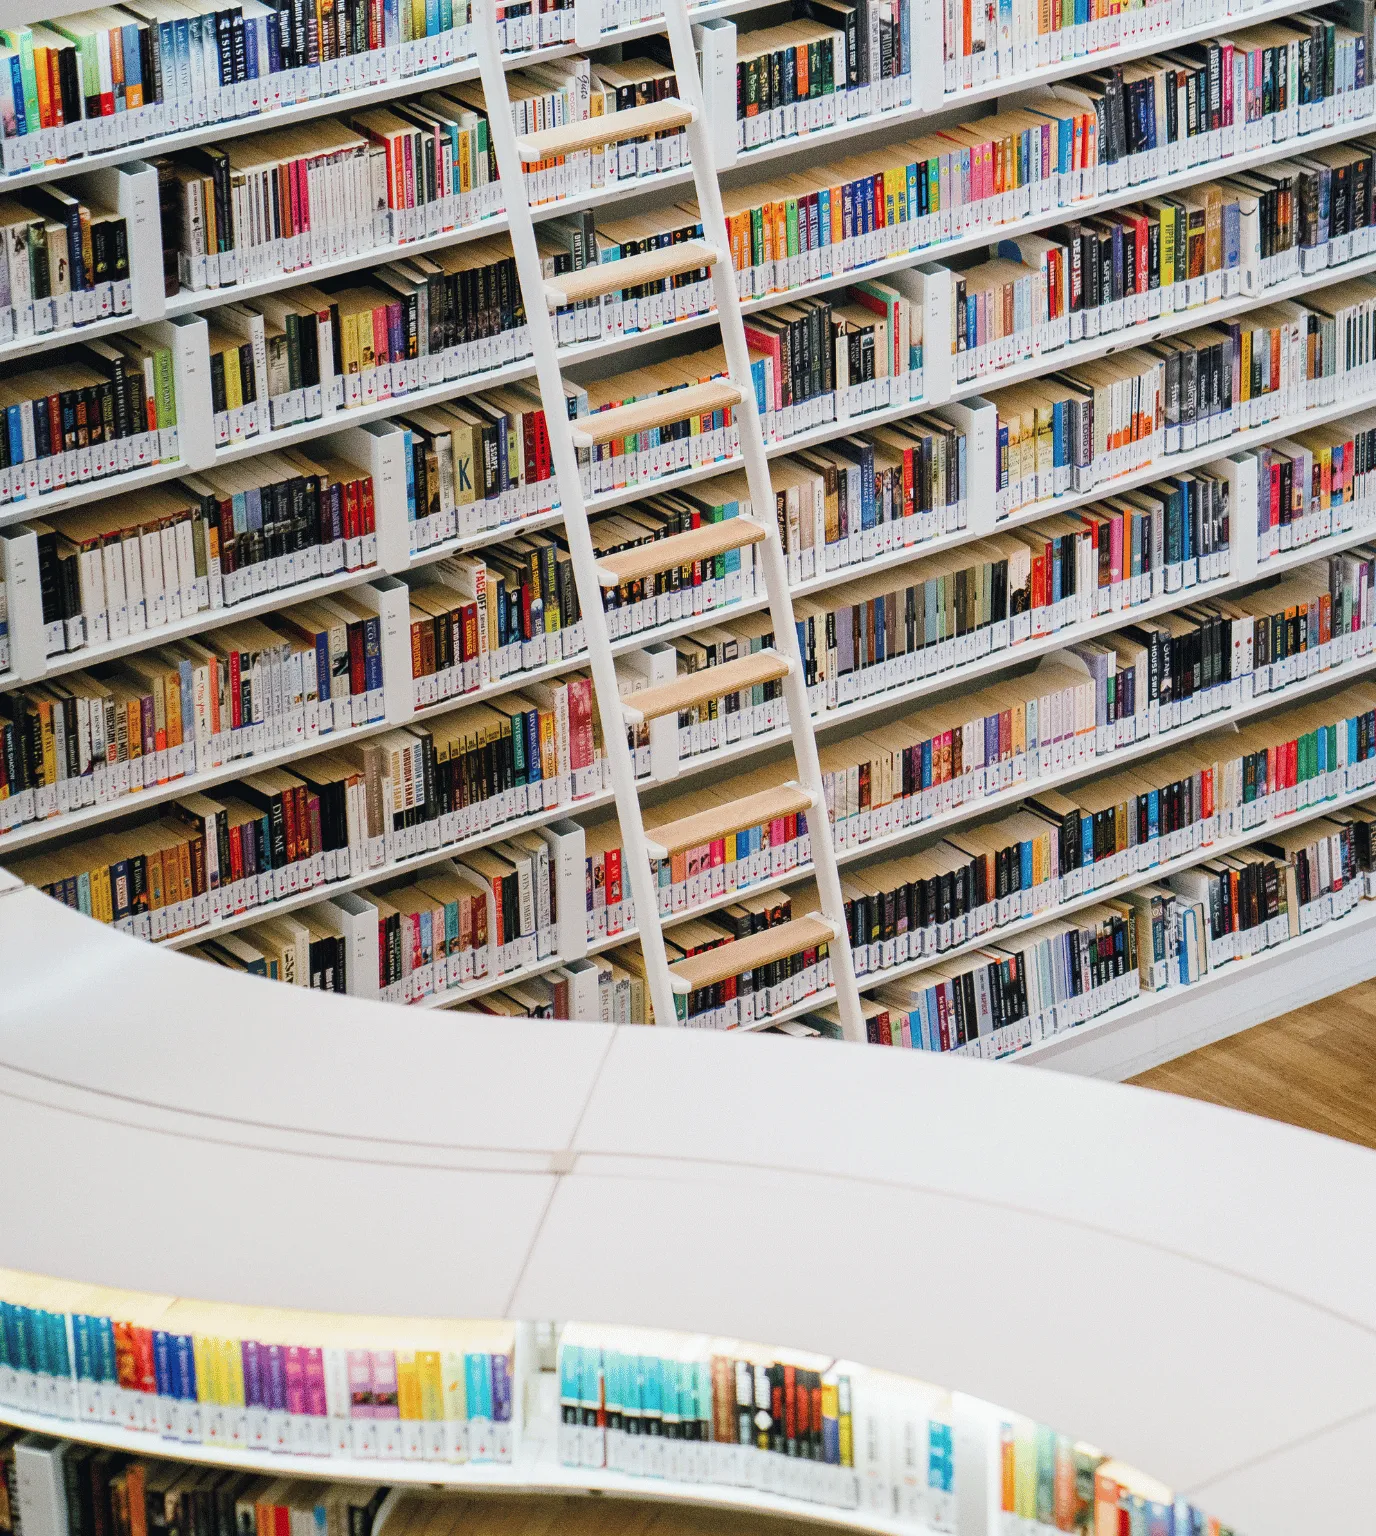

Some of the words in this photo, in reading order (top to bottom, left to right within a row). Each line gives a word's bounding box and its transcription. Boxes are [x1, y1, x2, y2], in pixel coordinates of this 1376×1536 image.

[280, 10, 289, 47] Singularity
[295, 28, 305, 52] Gravity
[337, 10, 346, 46] DOOMSDAY
[1210, 50, 1219, 79] JOSEPH
[131, 94, 140, 105] big
[1211, 81, 1219, 110] FINDER
[1072, 240, 1080, 269] DEAD
[1165, 246, 1173, 264] WINE
[408, 307, 417, 321] LONE
[409, 322, 417, 337] WOLF
[1187, 380, 1195, 416] silence
[1212, 370, 1220, 405] crescendo
[530, 553, 539, 569] LINDA
[547, 548, 555, 563] LINDA
[532, 570, 541, 599] FAIRSTEIN
[547, 564, 555, 592] FAIRSTEIN
[332, 628, 342, 653] ECO
[366, 622, 374, 640] ECO
[465, 620, 473, 655] EDDINGS
[106, 706, 115, 743] SIBERIAN
[118, 711, 126, 725] THE
[6, 732, 14, 754] WHITE
[118, 726, 126, 741] RED
[514, 717, 523, 766] RIVERWORLD
[529, 713, 539, 768] RIVERWORLD
[108, 744, 116, 760] RED
[414, 743, 422, 779] NURUDDIN
[7, 755, 15, 780] SHADOW
[403, 748, 411, 782] NURUDDIN
[404, 784, 413, 806] FARAH
[415, 780, 423, 803] FARAH
[273, 804, 282, 826] DIE
[275, 837, 284, 854] ME
[522, 873, 530, 888] EVEN
